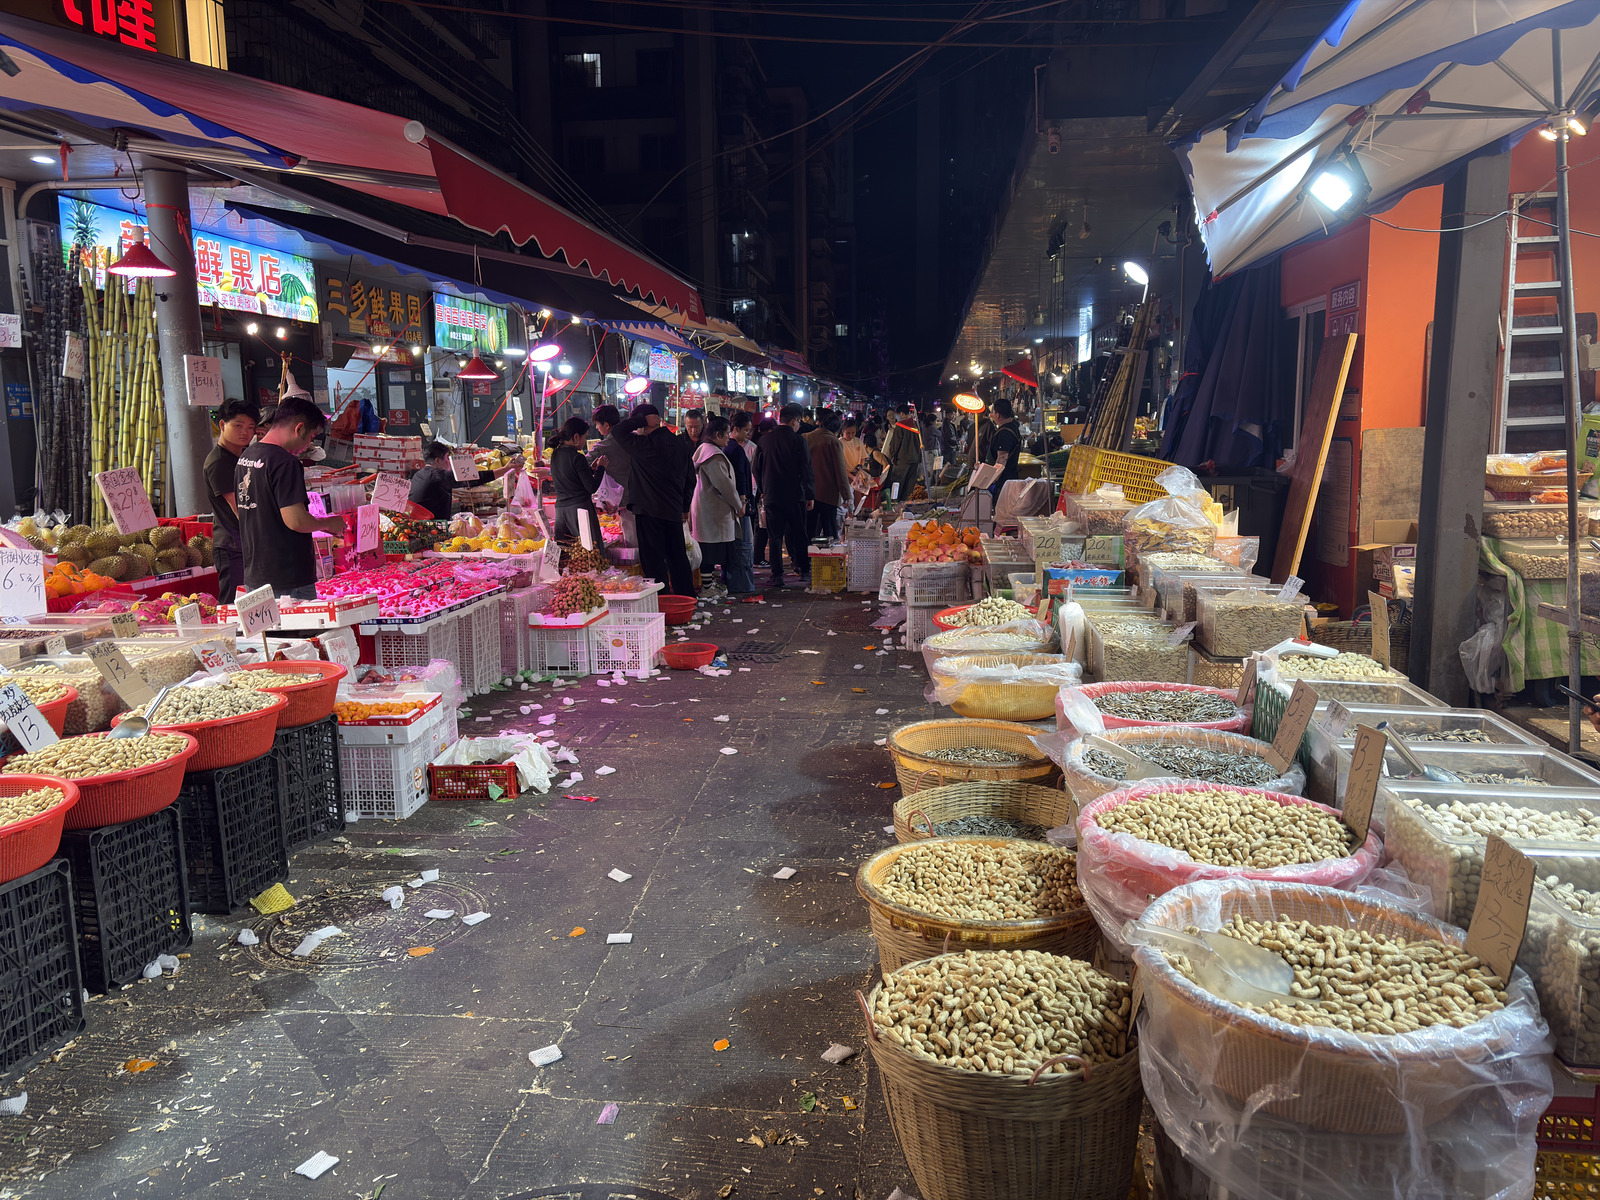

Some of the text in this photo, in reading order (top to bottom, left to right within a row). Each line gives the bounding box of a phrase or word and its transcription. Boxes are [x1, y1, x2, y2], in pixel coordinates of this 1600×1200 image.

[328, 279, 420, 328] 三多鲜果园
[1331, 287, 1355, 309] 服务内容
[104, 657, 127, 684] 13
[18, 714, 40, 746] 13
[1488, 839, 1526, 885] 现炒
[1475, 895, 1517, 962] 13元
